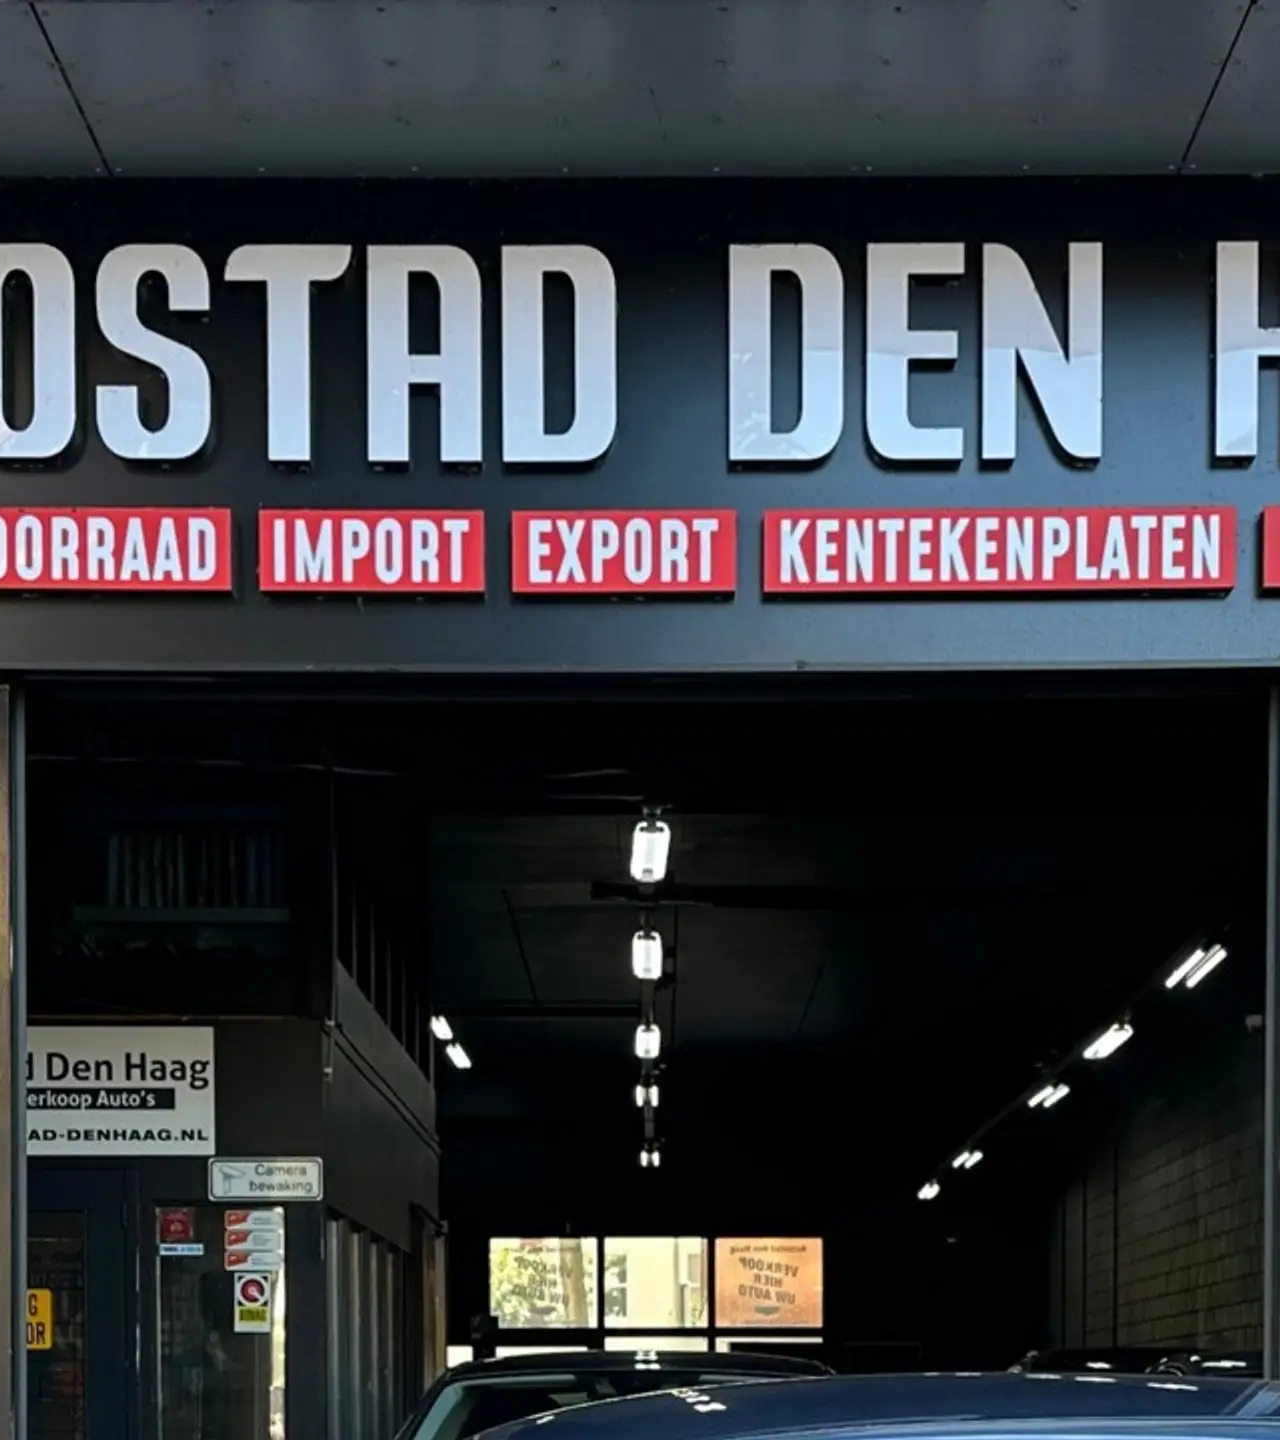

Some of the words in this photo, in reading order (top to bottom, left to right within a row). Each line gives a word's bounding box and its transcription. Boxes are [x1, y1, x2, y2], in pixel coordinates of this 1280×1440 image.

[729, 241, 1102, 460] DEN
[273, 517, 470, 583] IMPORT
[529, 517, 719, 583] EXPORT
[780, 514, 1220, 583] KENTEKENPLATEN
[46, 1052, 113, 1081] Den
[125, 1052, 210, 1089] Haag
[96, 1090, 155, 1107] Auto's
[249, 1180, 314, 1194] bewaking
[254, 1164, 308, 1177] Camera
